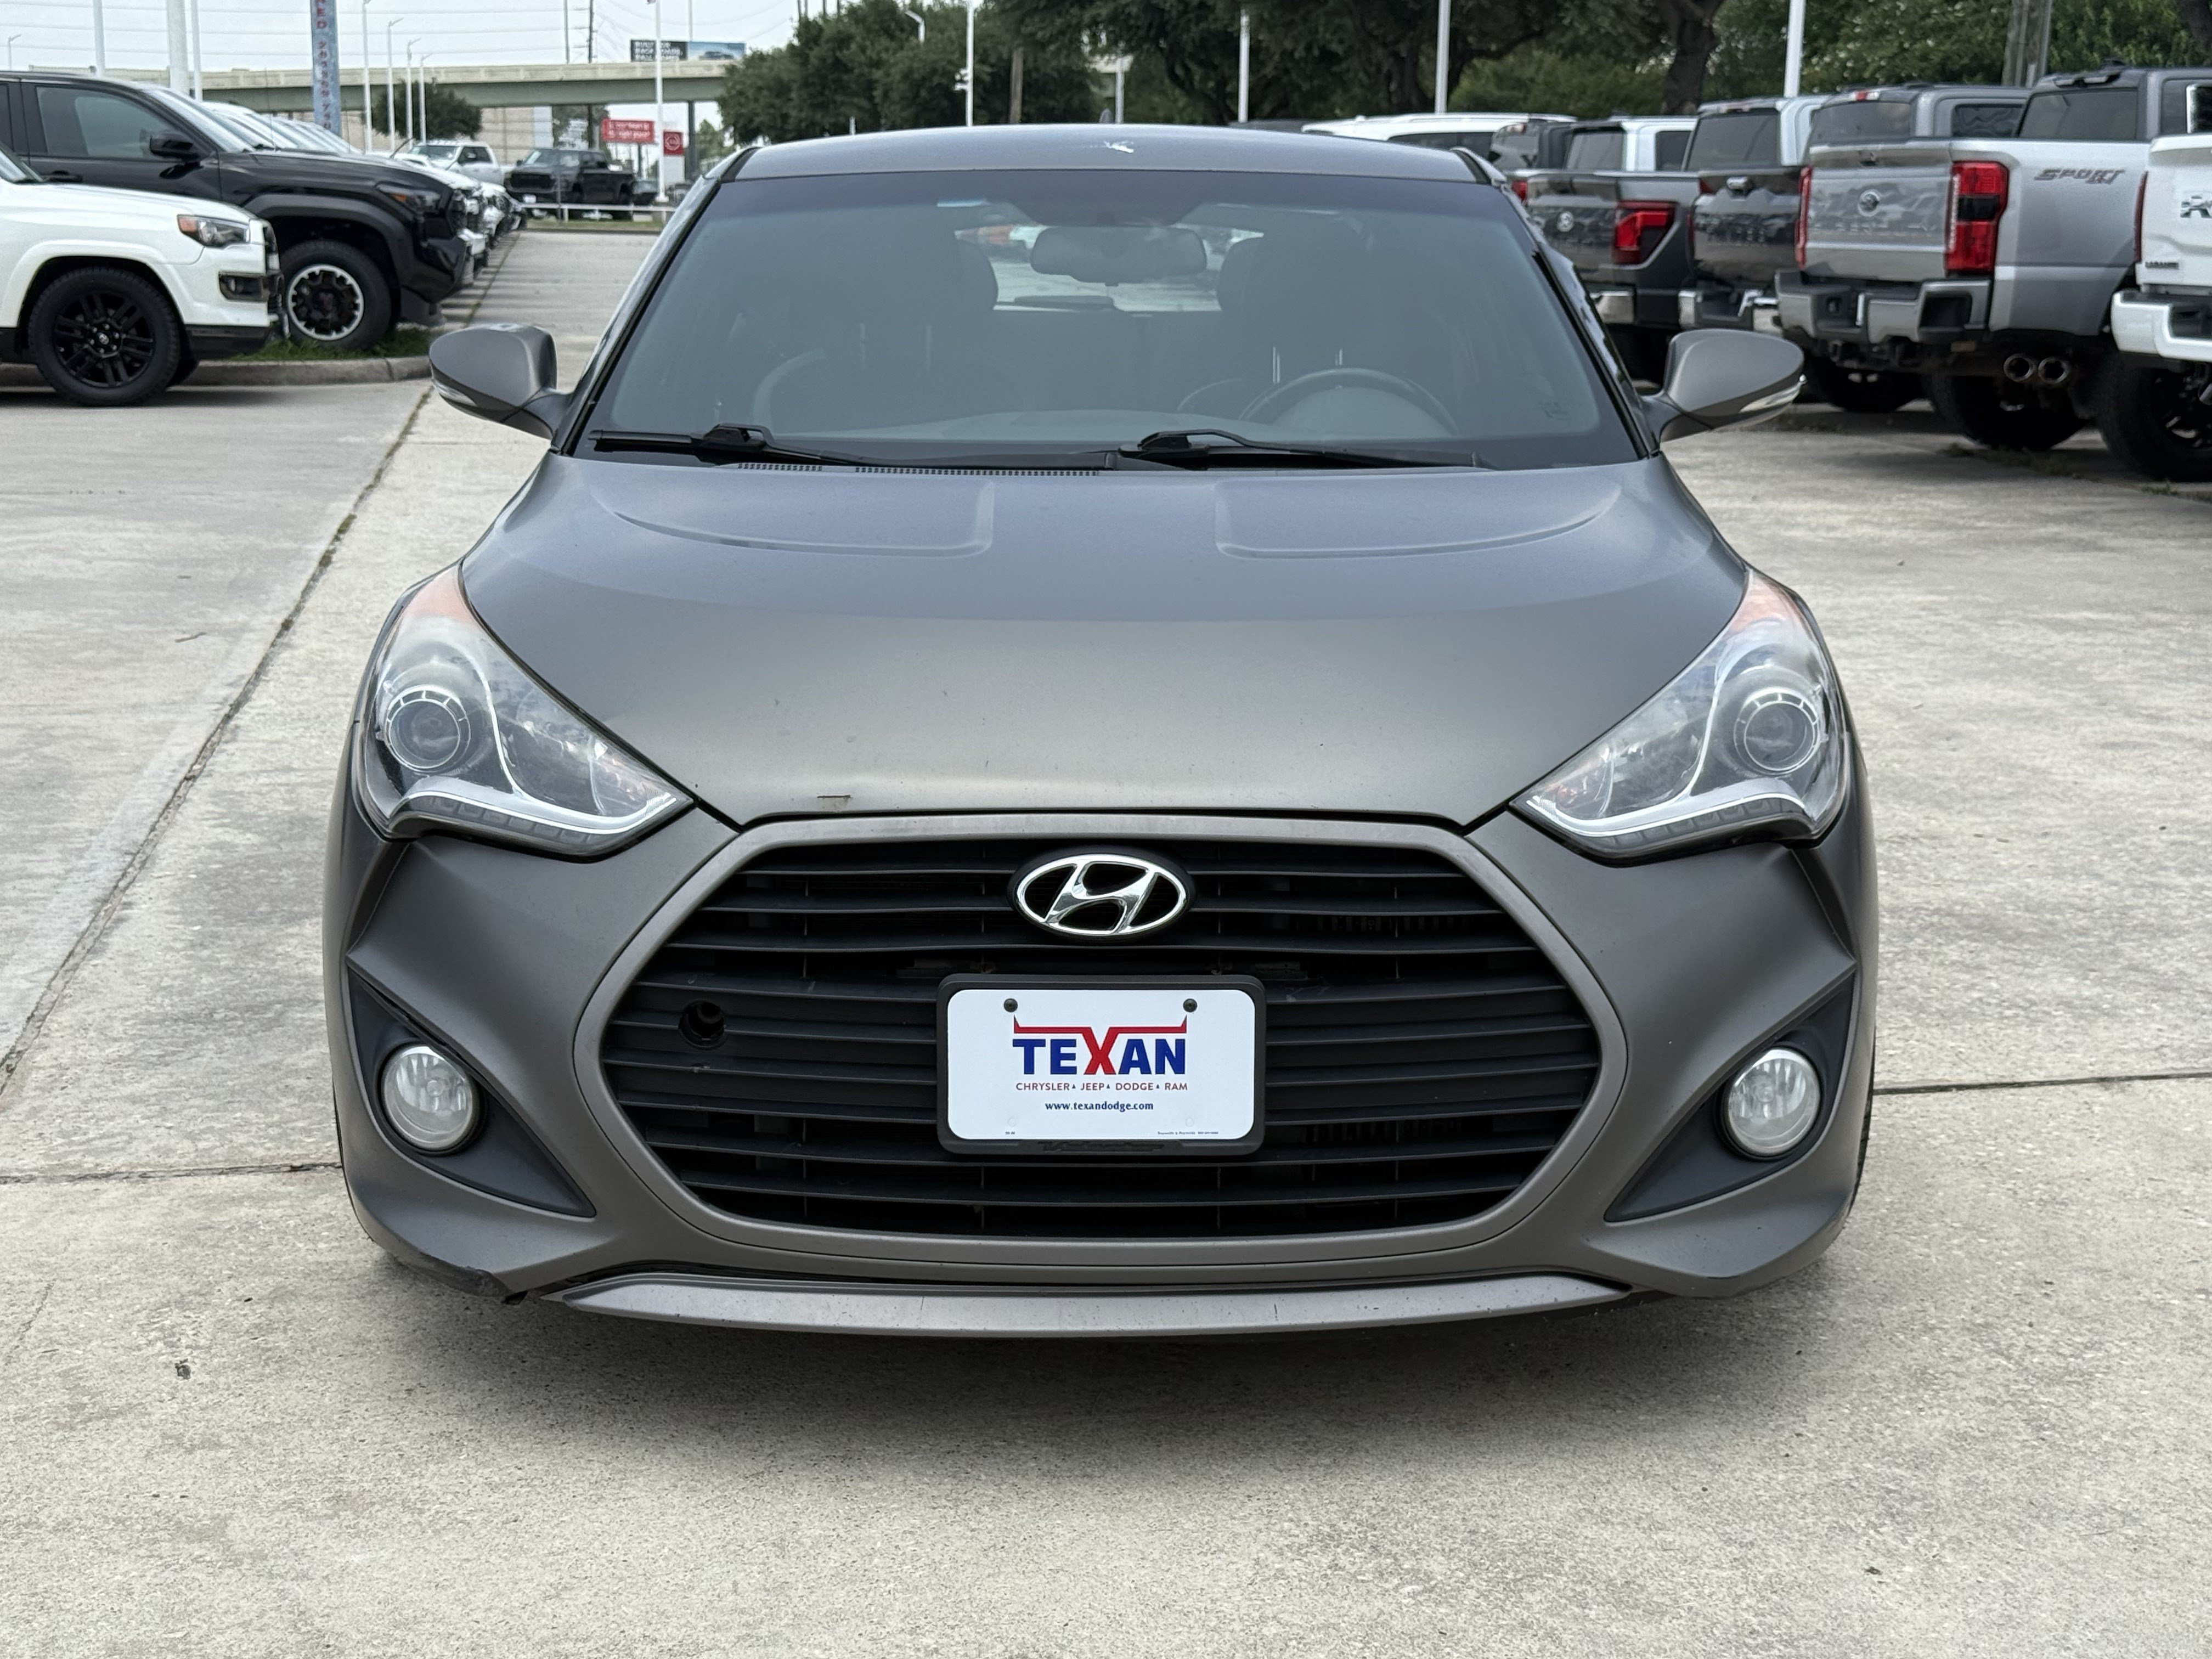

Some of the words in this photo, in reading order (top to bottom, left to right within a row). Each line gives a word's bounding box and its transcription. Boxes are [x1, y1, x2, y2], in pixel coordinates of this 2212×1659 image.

[2034, 168, 2126, 185] SPORT
[1012, 1025, 1186, 1075] TEXAN
[1015, 1082, 1070, 1091] CHRYSLER
[1080, 1082, 1105, 1091] JEEP
[1115, 1082, 1154, 1091] DODGE
[1165, 1082, 1188, 1091] RAM
[1045, 1101, 1154, 1113] www.texandodge.com
